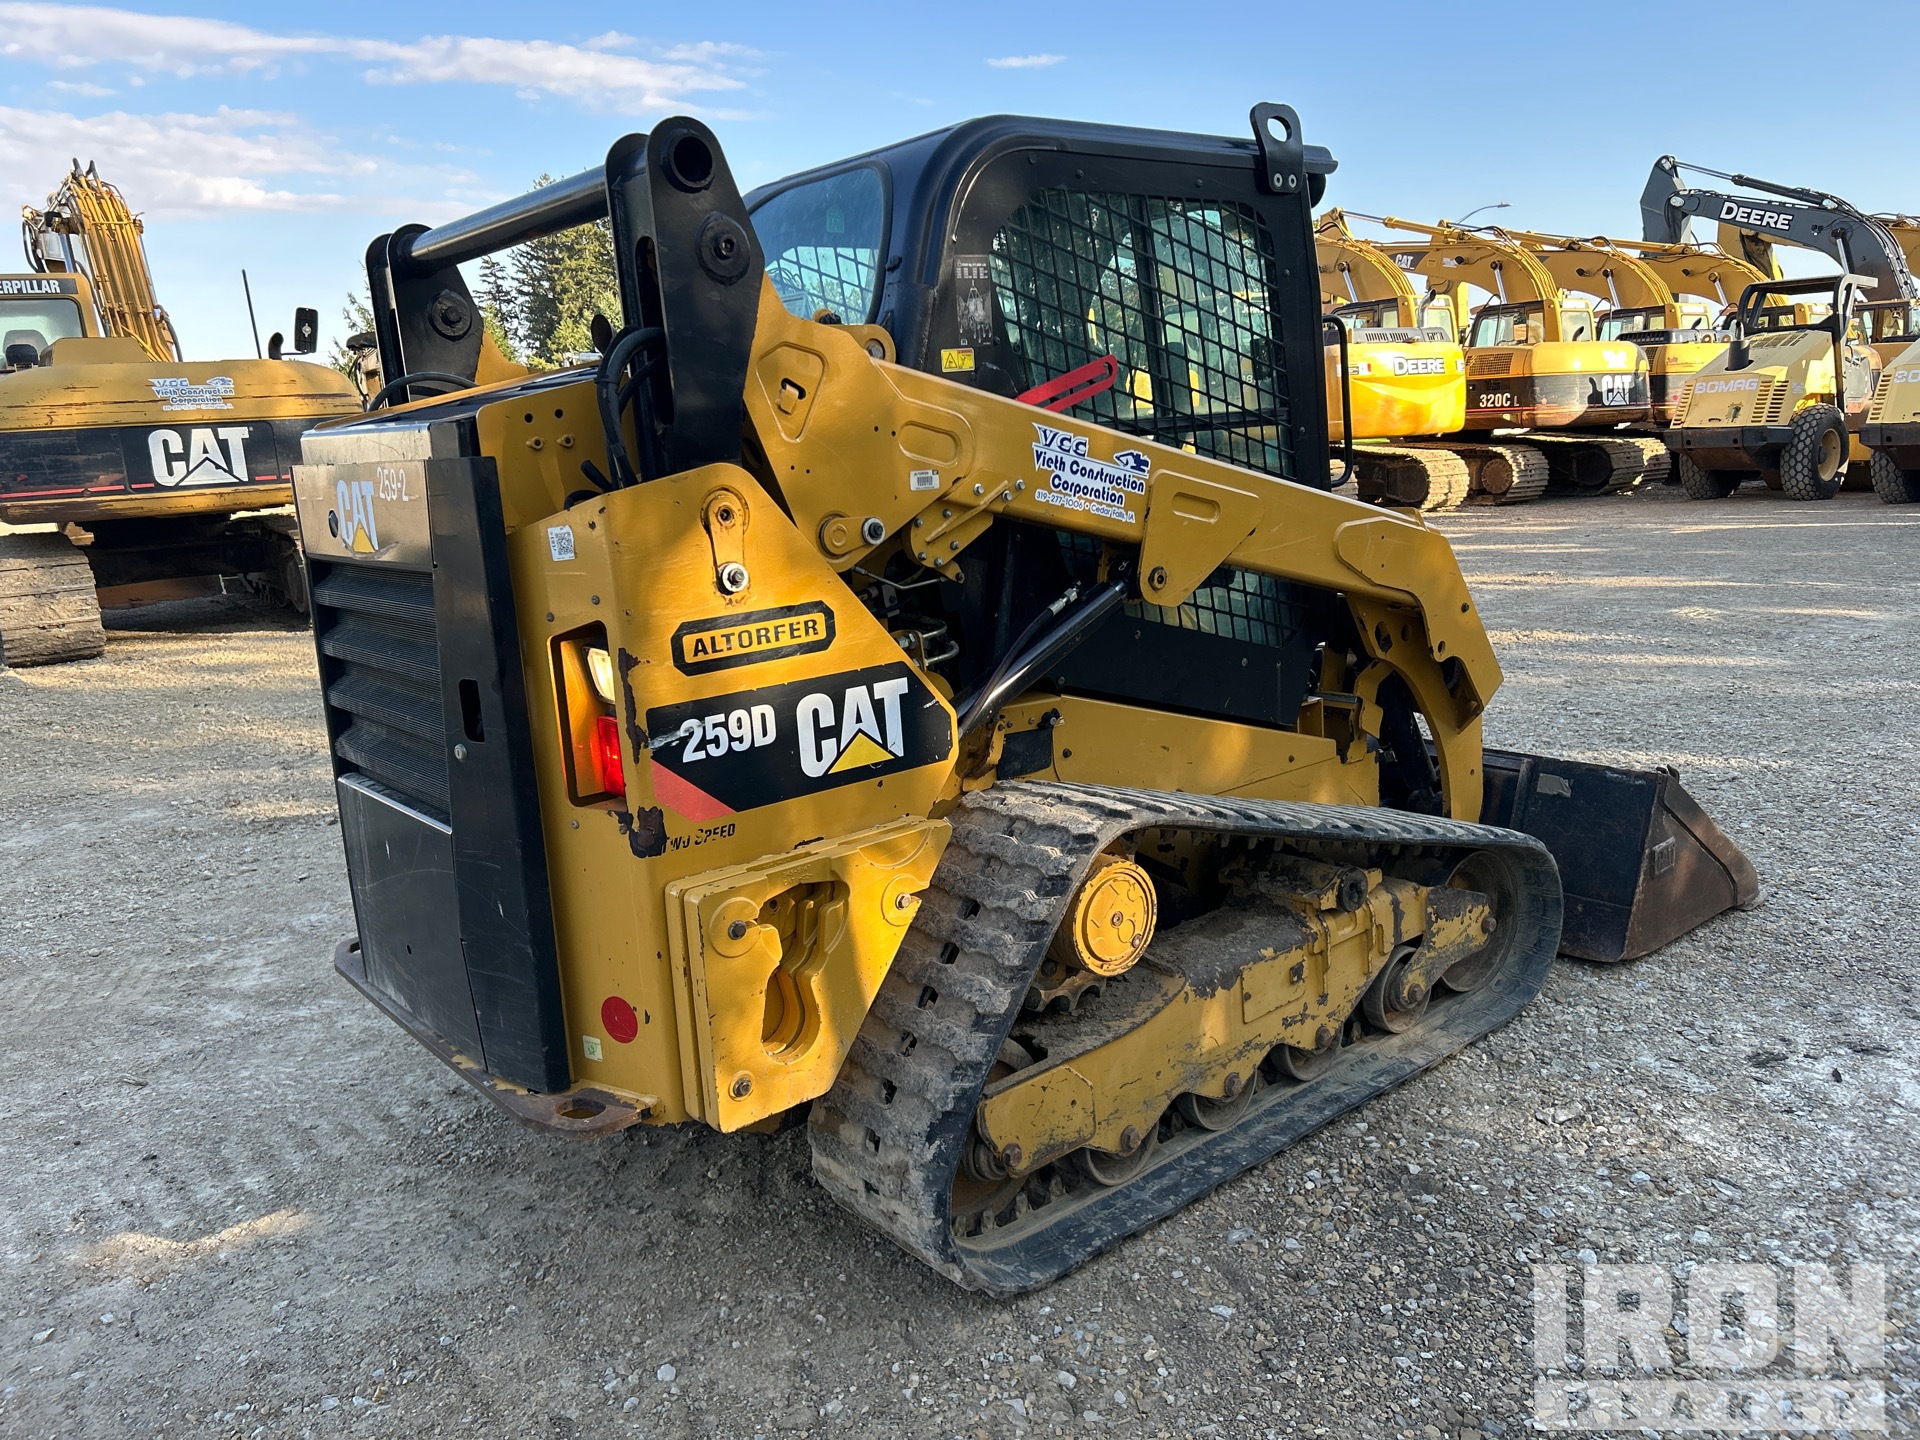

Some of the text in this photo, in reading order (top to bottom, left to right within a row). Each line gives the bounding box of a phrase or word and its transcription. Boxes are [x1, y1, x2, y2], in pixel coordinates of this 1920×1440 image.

[1720, 201, 1793, 230] DEERE
[1395, 254, 1413, 269] CAT
[1394, 357, 1445, 376] DEERE
[170, 396, 222, 404] Corporation
[180, 387, 234, 396] Construction
[1479, 393, 1520, 408] 320C L
[1602, 375, 1634, 406] CAT
[1694, 378, 1759, 394] BOMAG
[148, 427, 249, 486] CAT
[1037, 425, 1088, 457] VCC
[377, 467, 409, 502] 259-2
[1034, 449, 1145, 493] Vieth Construction
[1036, 491, 1083, 509] 319-277-1006
[1091, 503, 1112, 516] Cedar
[1051, 473, 1124, 506] Corporation
[336, 479, 379, 552] CAT
[692, 619, 819, 657] ALTORFER
[679, 704, 777, 763] 259D
[796, 677, 908, 777] CAT
[694, 823, 736, 846] SPEED
